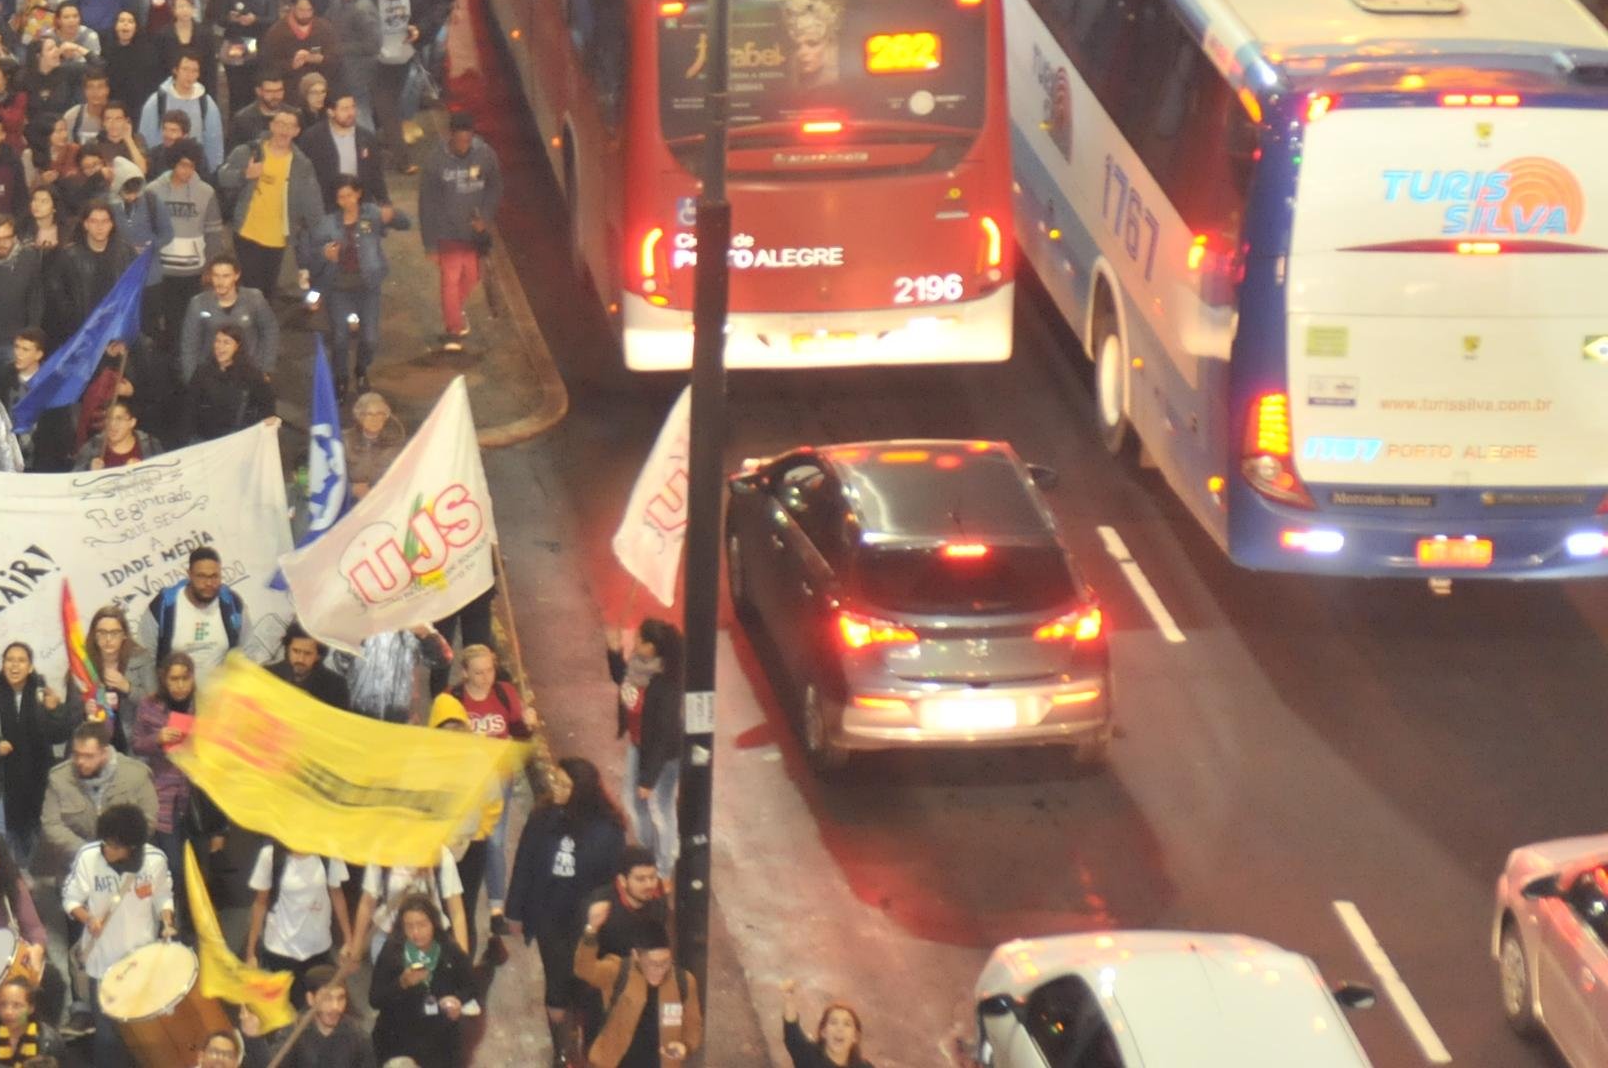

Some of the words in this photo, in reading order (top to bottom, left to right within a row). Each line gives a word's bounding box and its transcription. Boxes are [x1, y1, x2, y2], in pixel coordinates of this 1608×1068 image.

[1381, 169, 1513, 203] TURIS
[1441, 203, 1570, 235] SILVA
[755, 247, 844, 267] ALEGRE
[894, 273, 963, 304] 2196
[1387, 444, 1453, 459] PORTO
[1463, 444, 1539, 459] ALEGRE
[349, 483, 483, 605] UJS
[101, 554, 154, 589] IDADE
